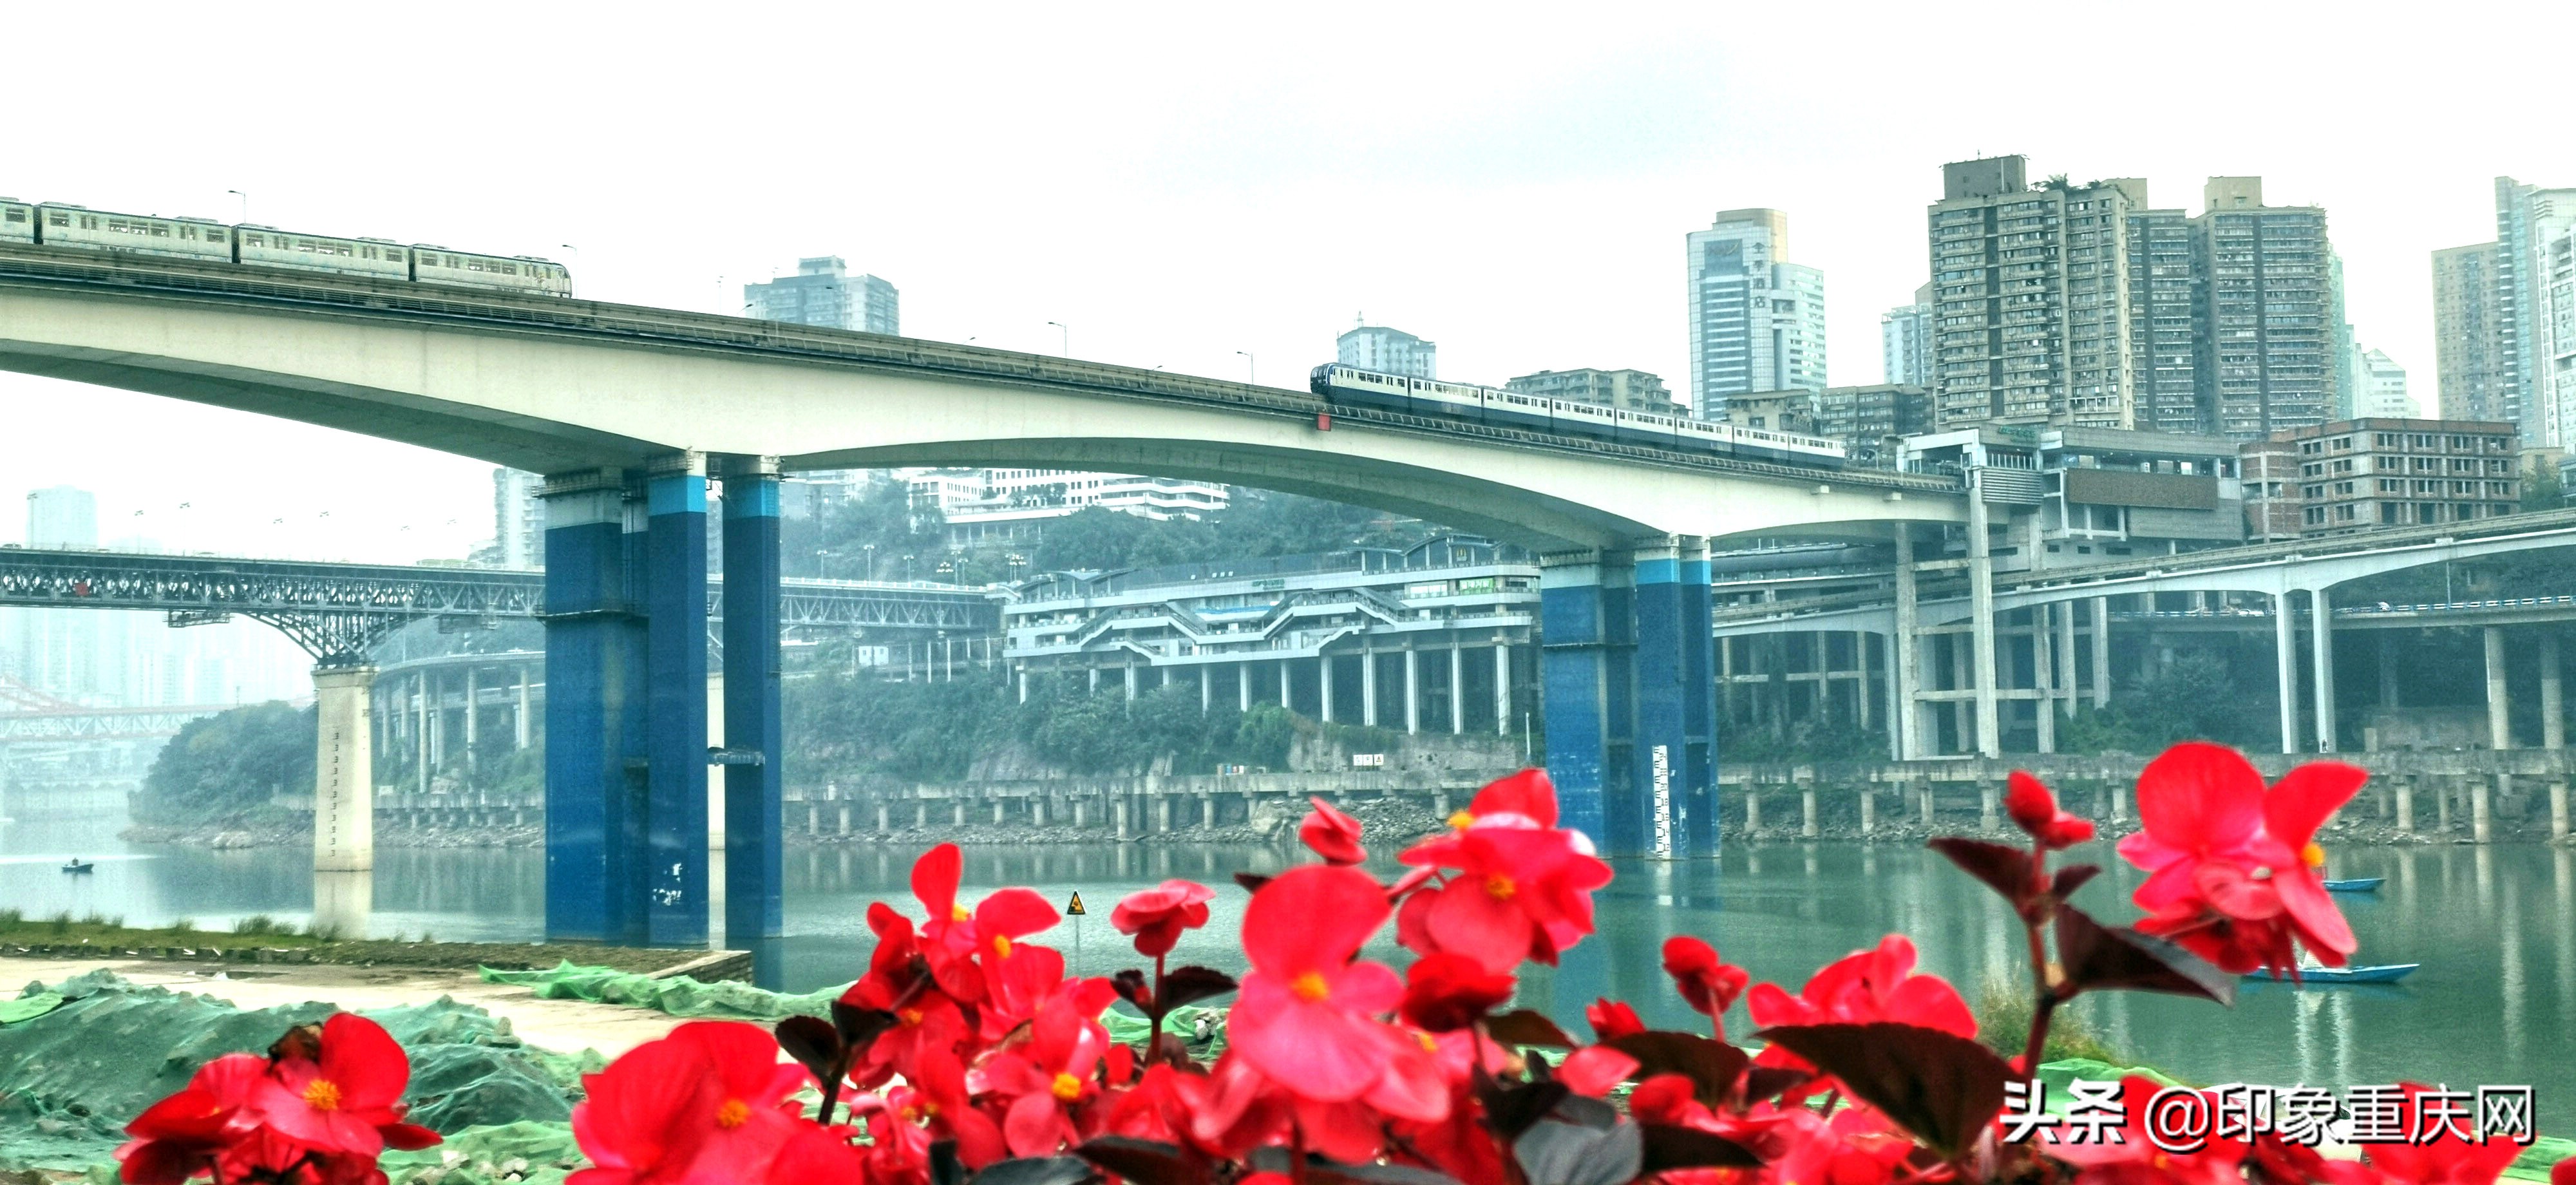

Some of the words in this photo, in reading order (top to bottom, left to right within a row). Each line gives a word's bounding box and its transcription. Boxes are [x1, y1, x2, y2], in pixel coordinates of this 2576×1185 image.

[1752, 242, 1766, 308] 全季酒店
[1662, 828, 1670, 837] 14
